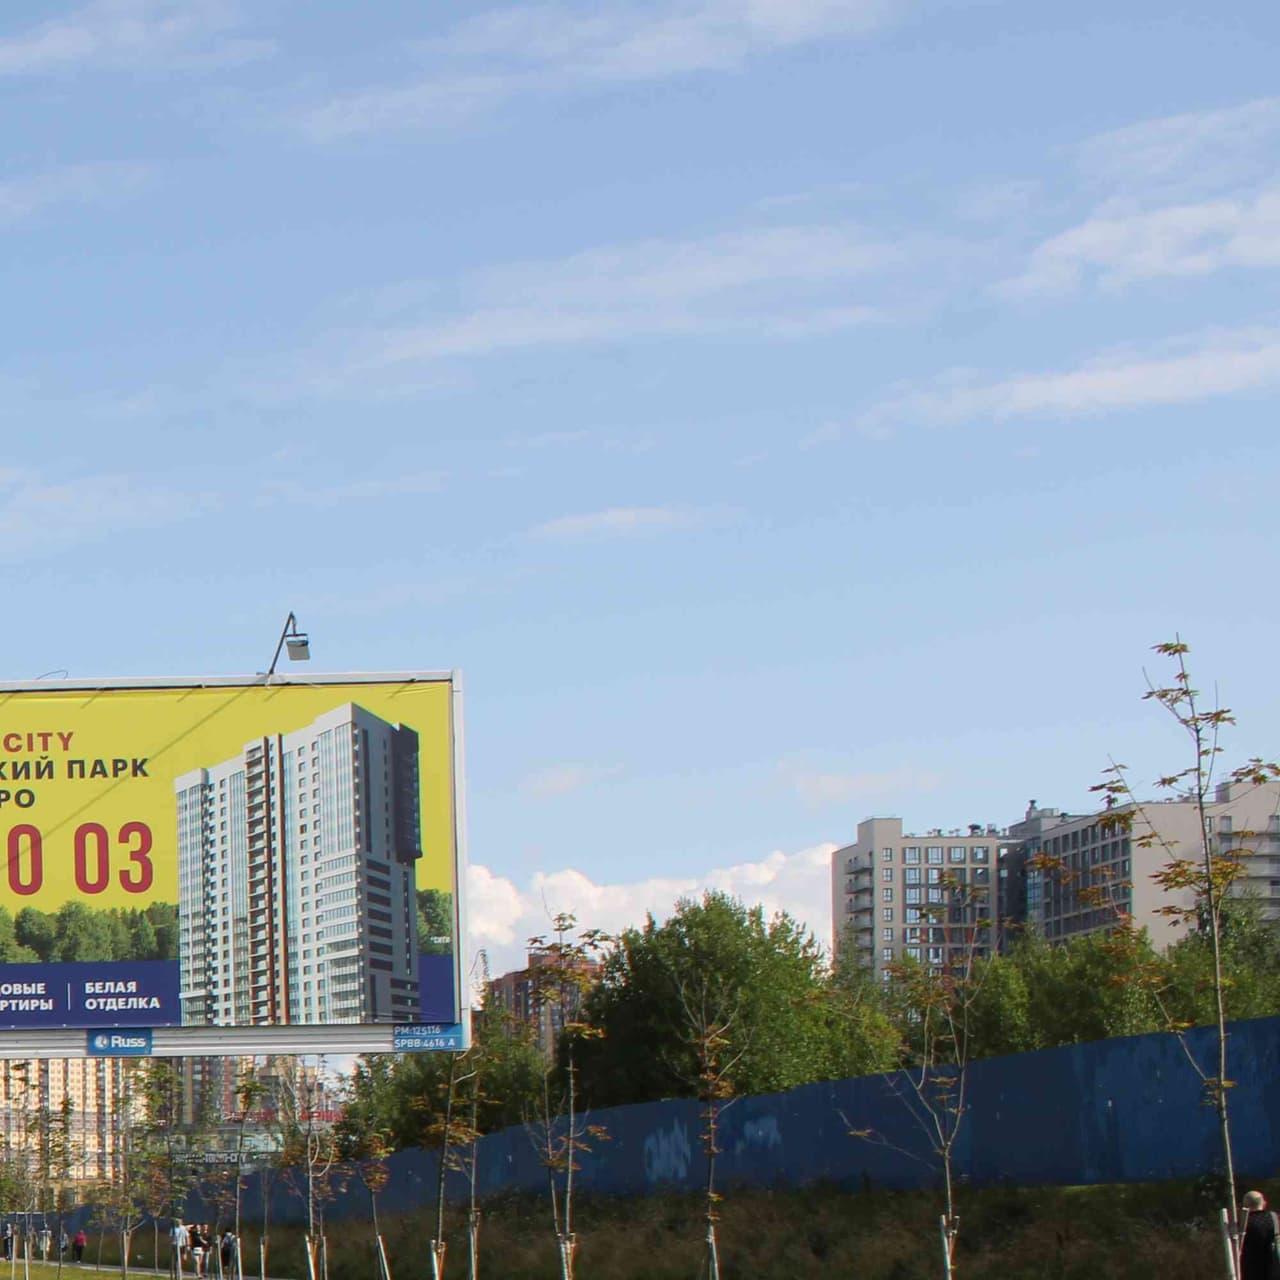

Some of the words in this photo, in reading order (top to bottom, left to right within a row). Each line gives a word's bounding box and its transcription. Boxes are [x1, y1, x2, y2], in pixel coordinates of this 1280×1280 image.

[3, 731, 74, 753] CITY
[66, 757, 149, 779] ПАРК
[73, 820, 154, 894] 03
[84, 981, 137, 994] БЕЛАЯ
[84, 997, 161, 1011] ОТДЕЛКА
[111, 1035, 146, 1048] Russ
